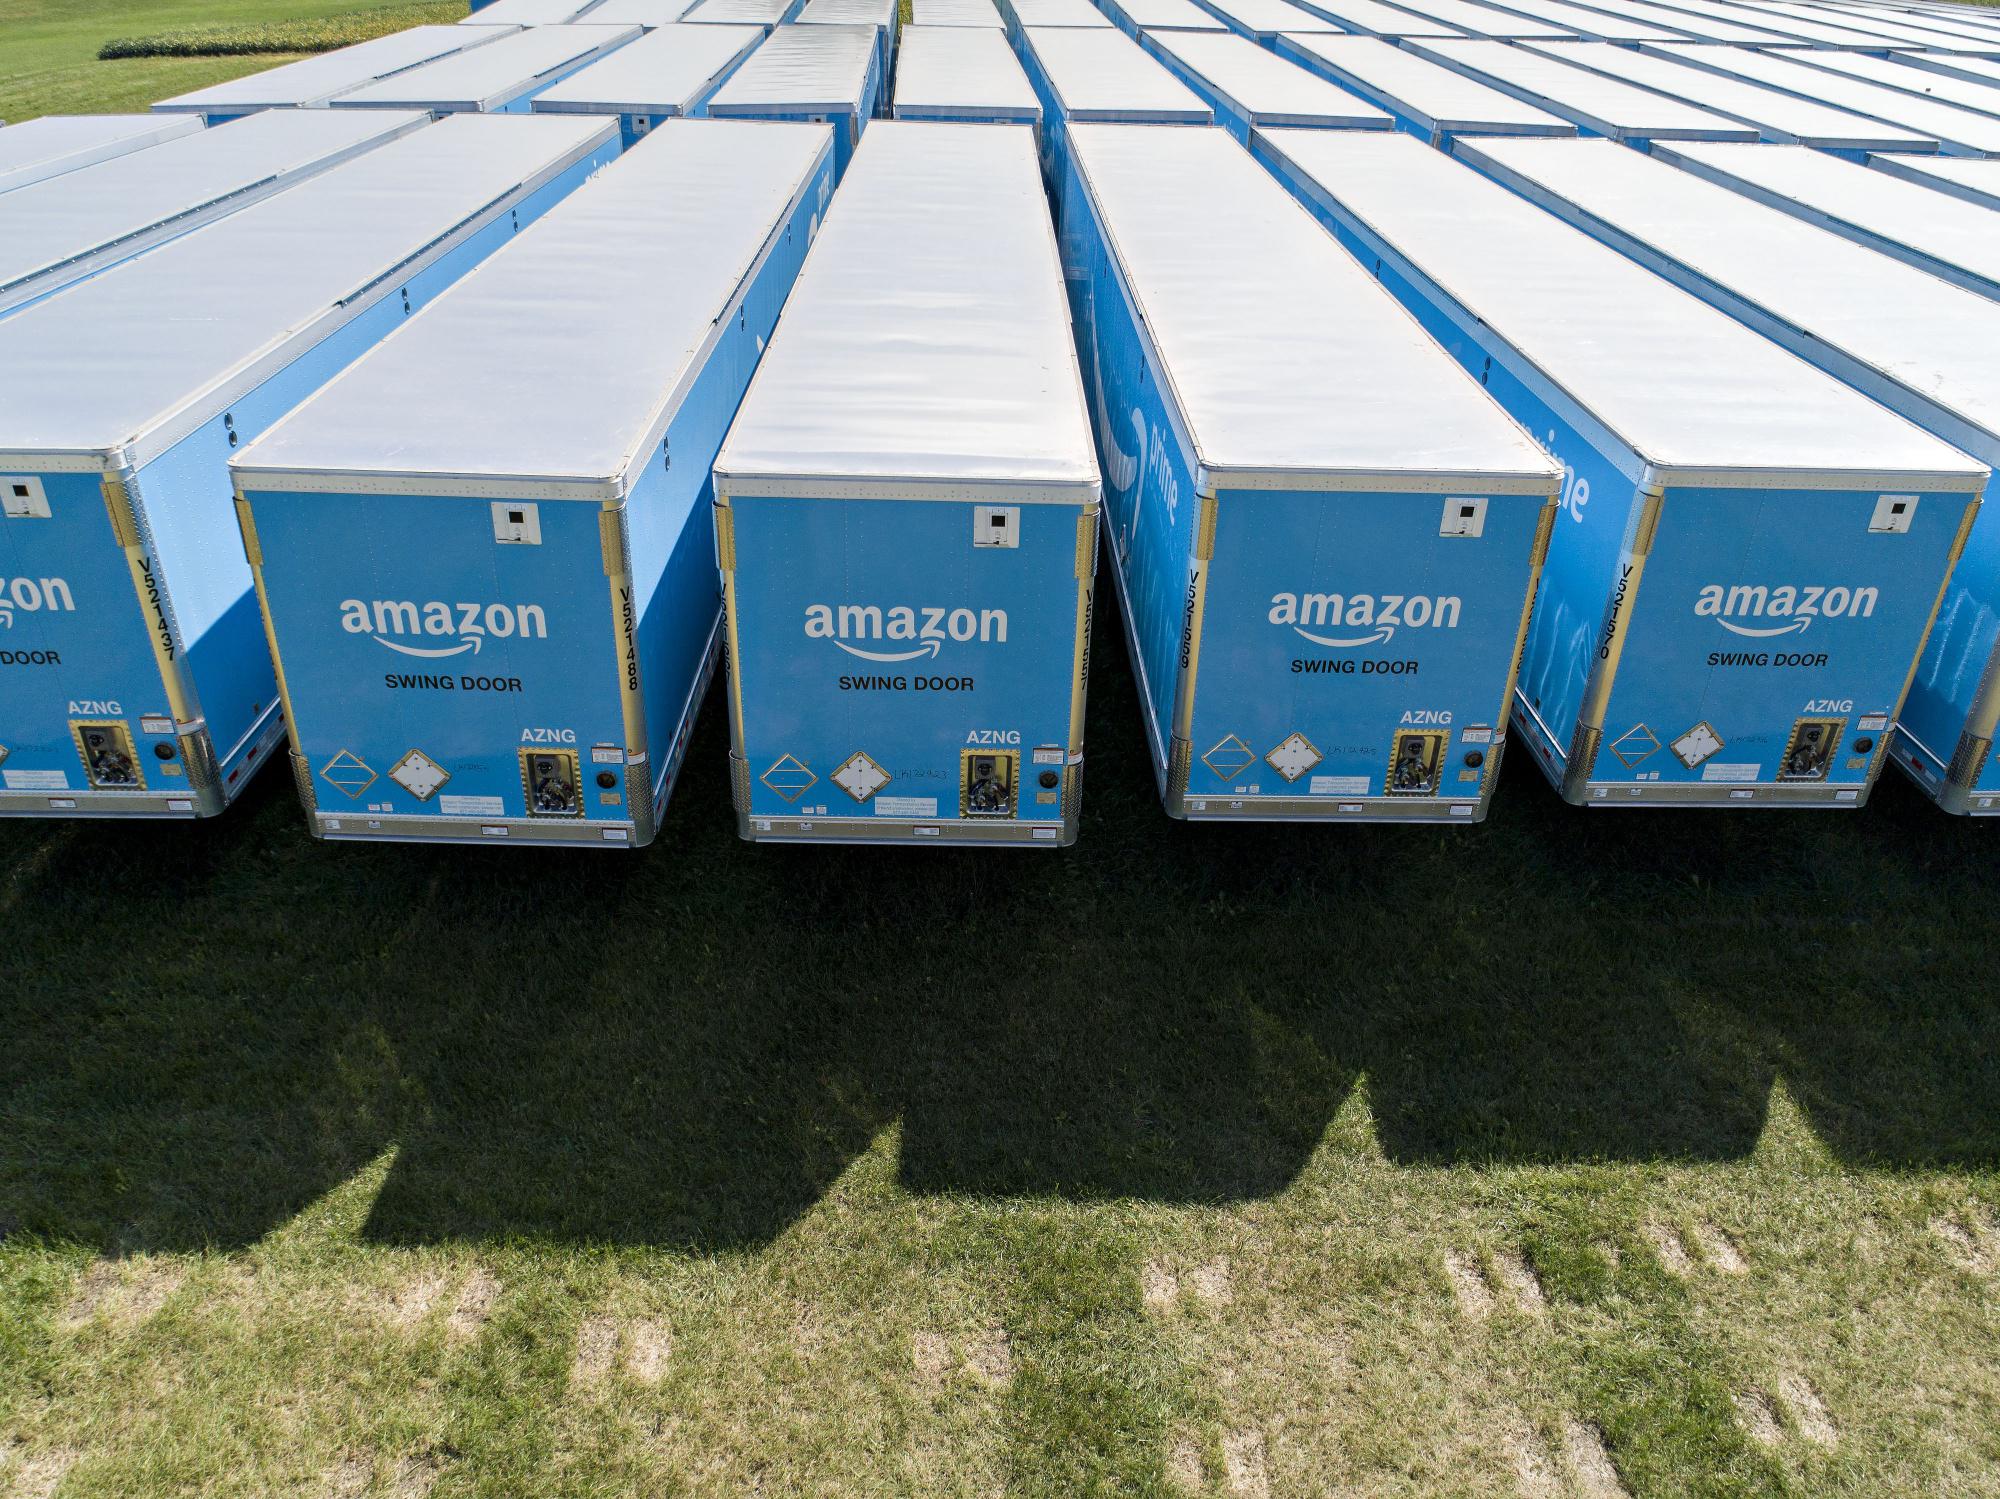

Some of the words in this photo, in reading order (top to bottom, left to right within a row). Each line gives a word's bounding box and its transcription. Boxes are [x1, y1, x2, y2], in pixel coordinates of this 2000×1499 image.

[1149, 422, 1178, 527] prime
[137, 557, 175, 662] V521437
[1694, 584, 1879, 618] amazon
[340, 599, 547, 639] amazon
[1181, 569, 1200, 668] V521559
[1268, 592, 1462, 629] amazon
[1600, 563, 1634, 660] V521570
[804, 604, 1008, 643] amazon
[620, 586, 638, 691] V521488
[1, 651, 62, 665] DOOR
[1707, 653, 1768, 667] SWING
[1774, 654, 1829, 667] DOOR
[1291, 660, 1355, 674] SWING
[1361, 661, 1419, 675] DOOR
[385, 674, 455, 690] SWING
[461, 676, 522, 692] DOOR
[839, 676, 907, 691] SWING
[914, 677, 974, 691] DOOR
[69, 701, 123, 715] AZNG
[1804, 700, 1853, 713] AZNG
[1400, 711, 1452, 725] AZNG
[521, 728, 576, 743] AZNG
[967, 730, 1021, 744] AZNG
